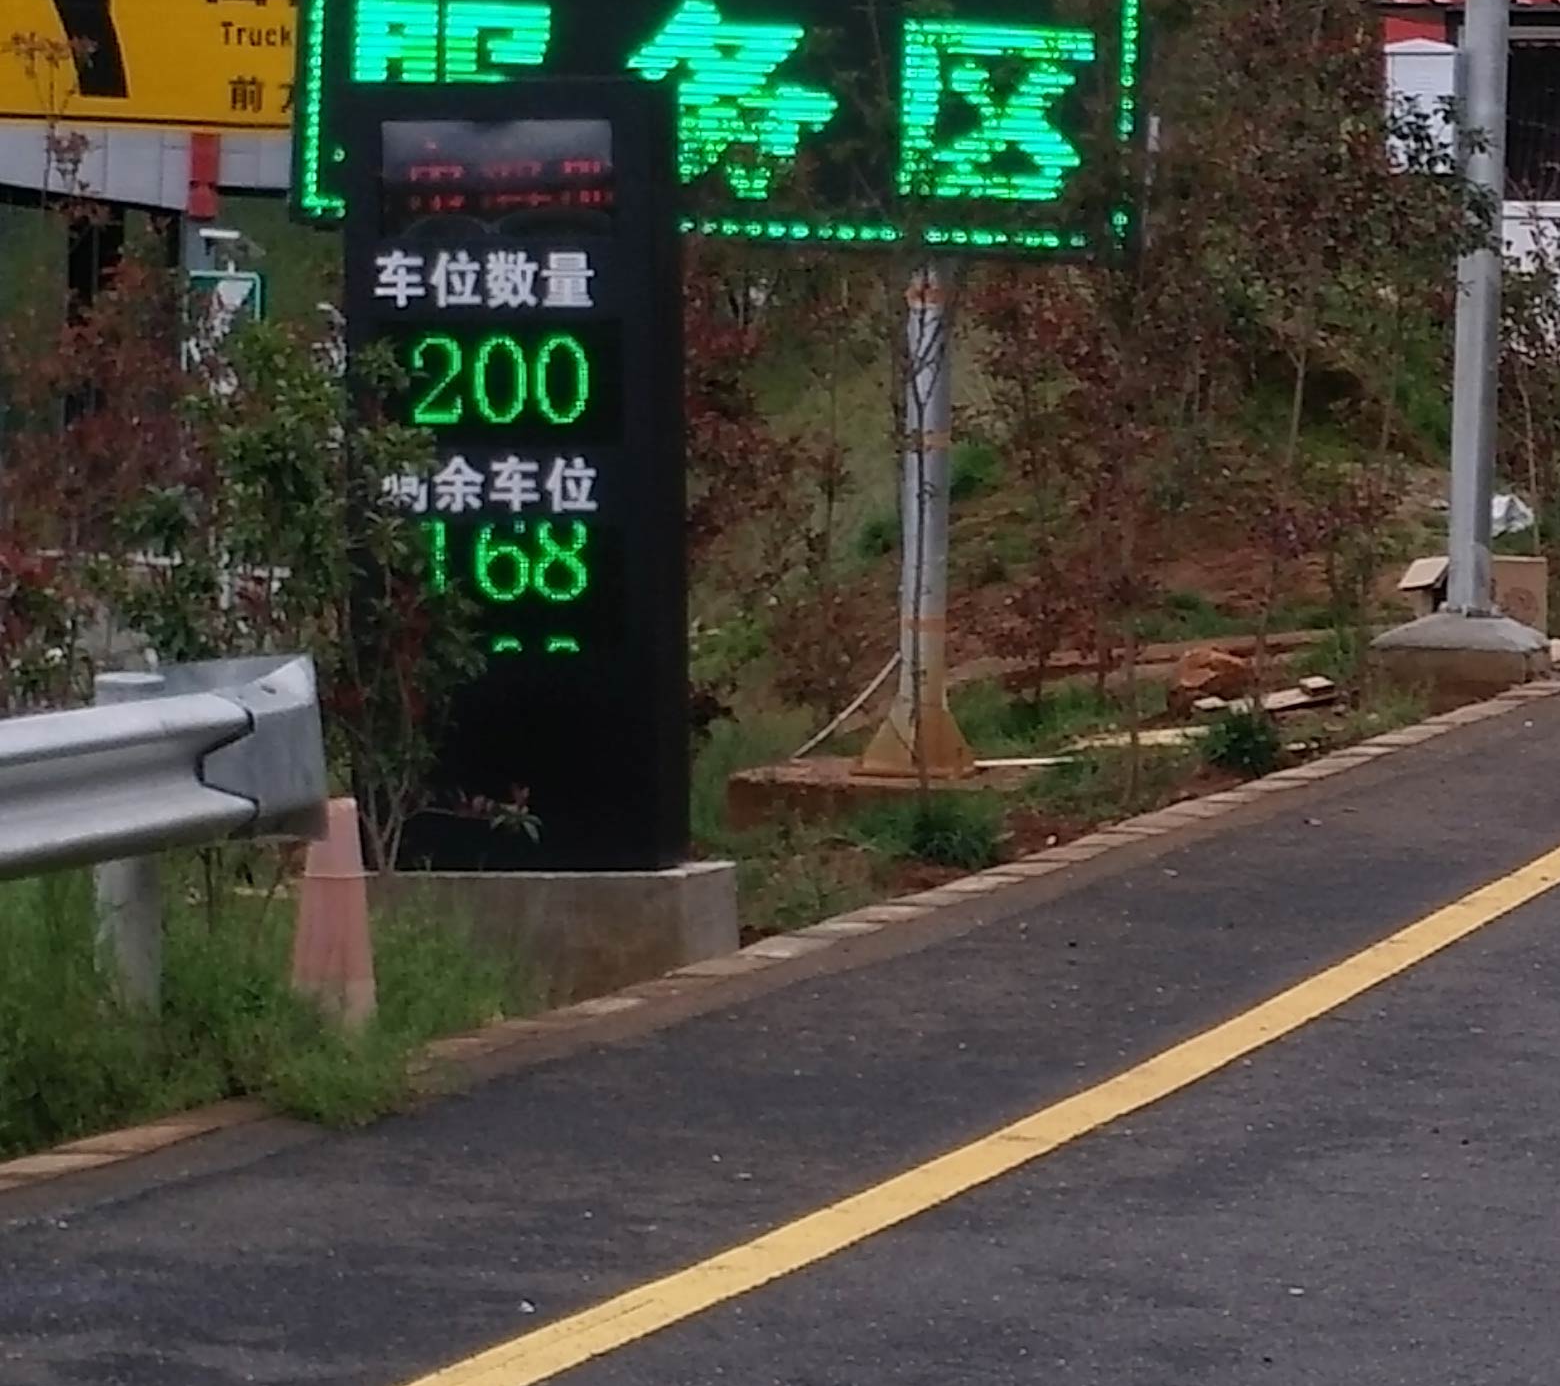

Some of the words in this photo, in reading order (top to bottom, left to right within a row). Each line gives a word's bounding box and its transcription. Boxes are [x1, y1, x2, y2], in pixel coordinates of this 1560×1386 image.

[221, 21, 293, 47] Truck
[373, 249, 595, 309] 车位数量
[412, 335, 590, 425] 200
[422, 520, 588, 602] 168
